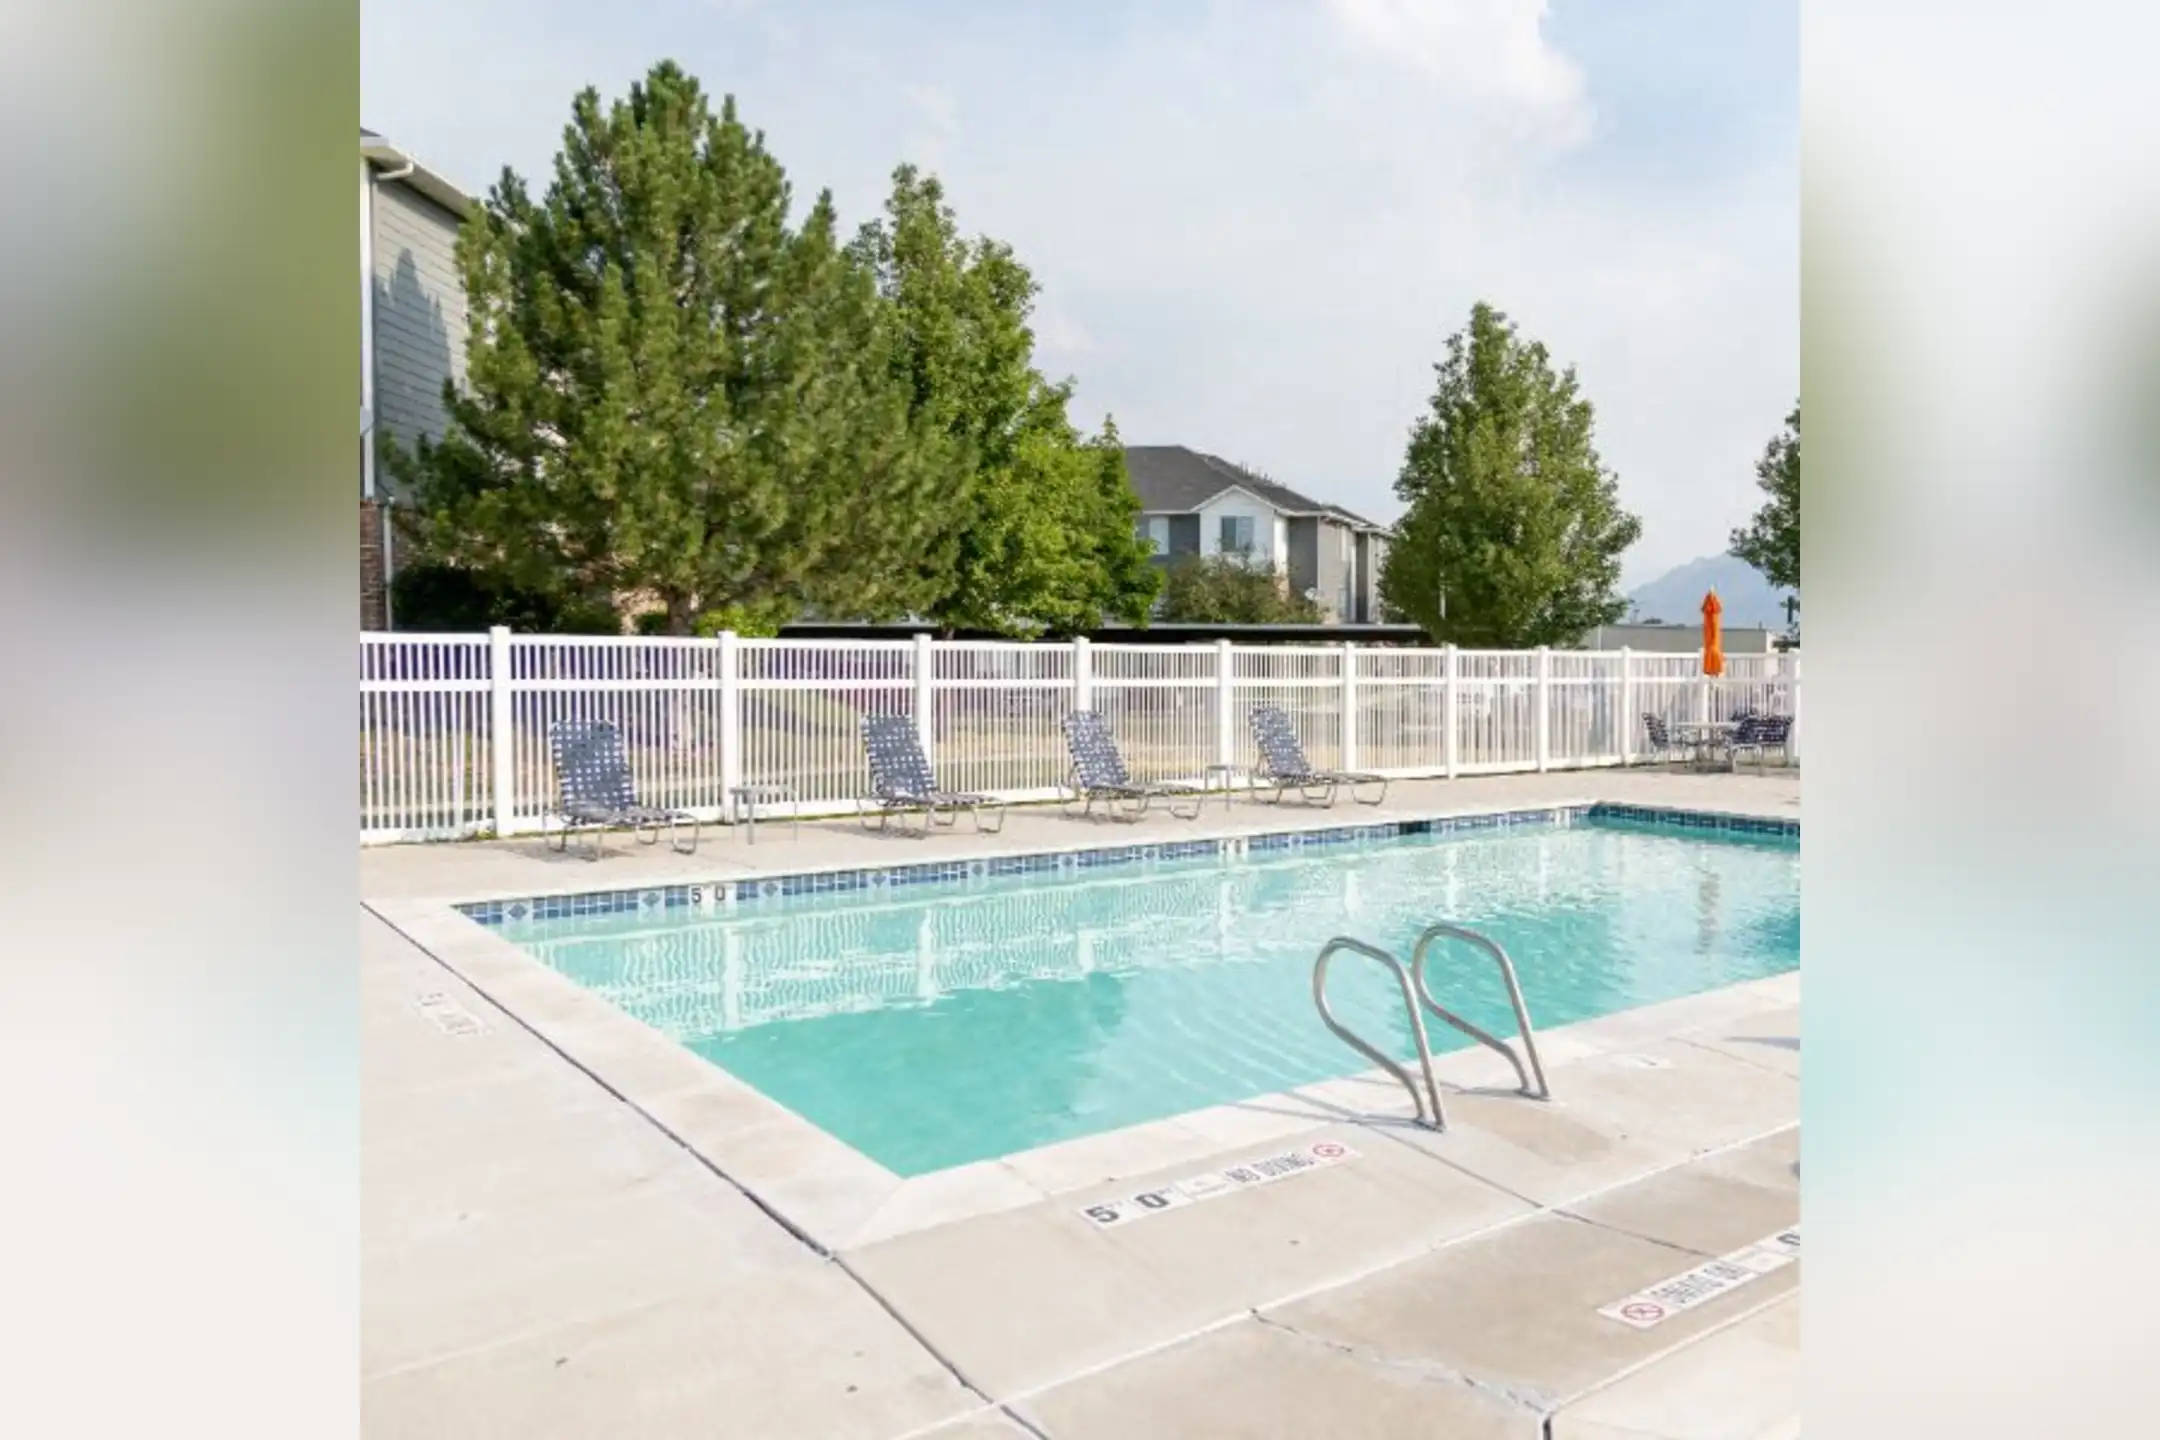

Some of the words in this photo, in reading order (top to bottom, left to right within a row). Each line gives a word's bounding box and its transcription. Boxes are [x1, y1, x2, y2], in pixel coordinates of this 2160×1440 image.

[691, 886, 702, 904] 5
[714, 884, 726, 901] 0
[1085, 1205, 1120, 1222] 5
[1134, 1192, 1169, 1208] 0
